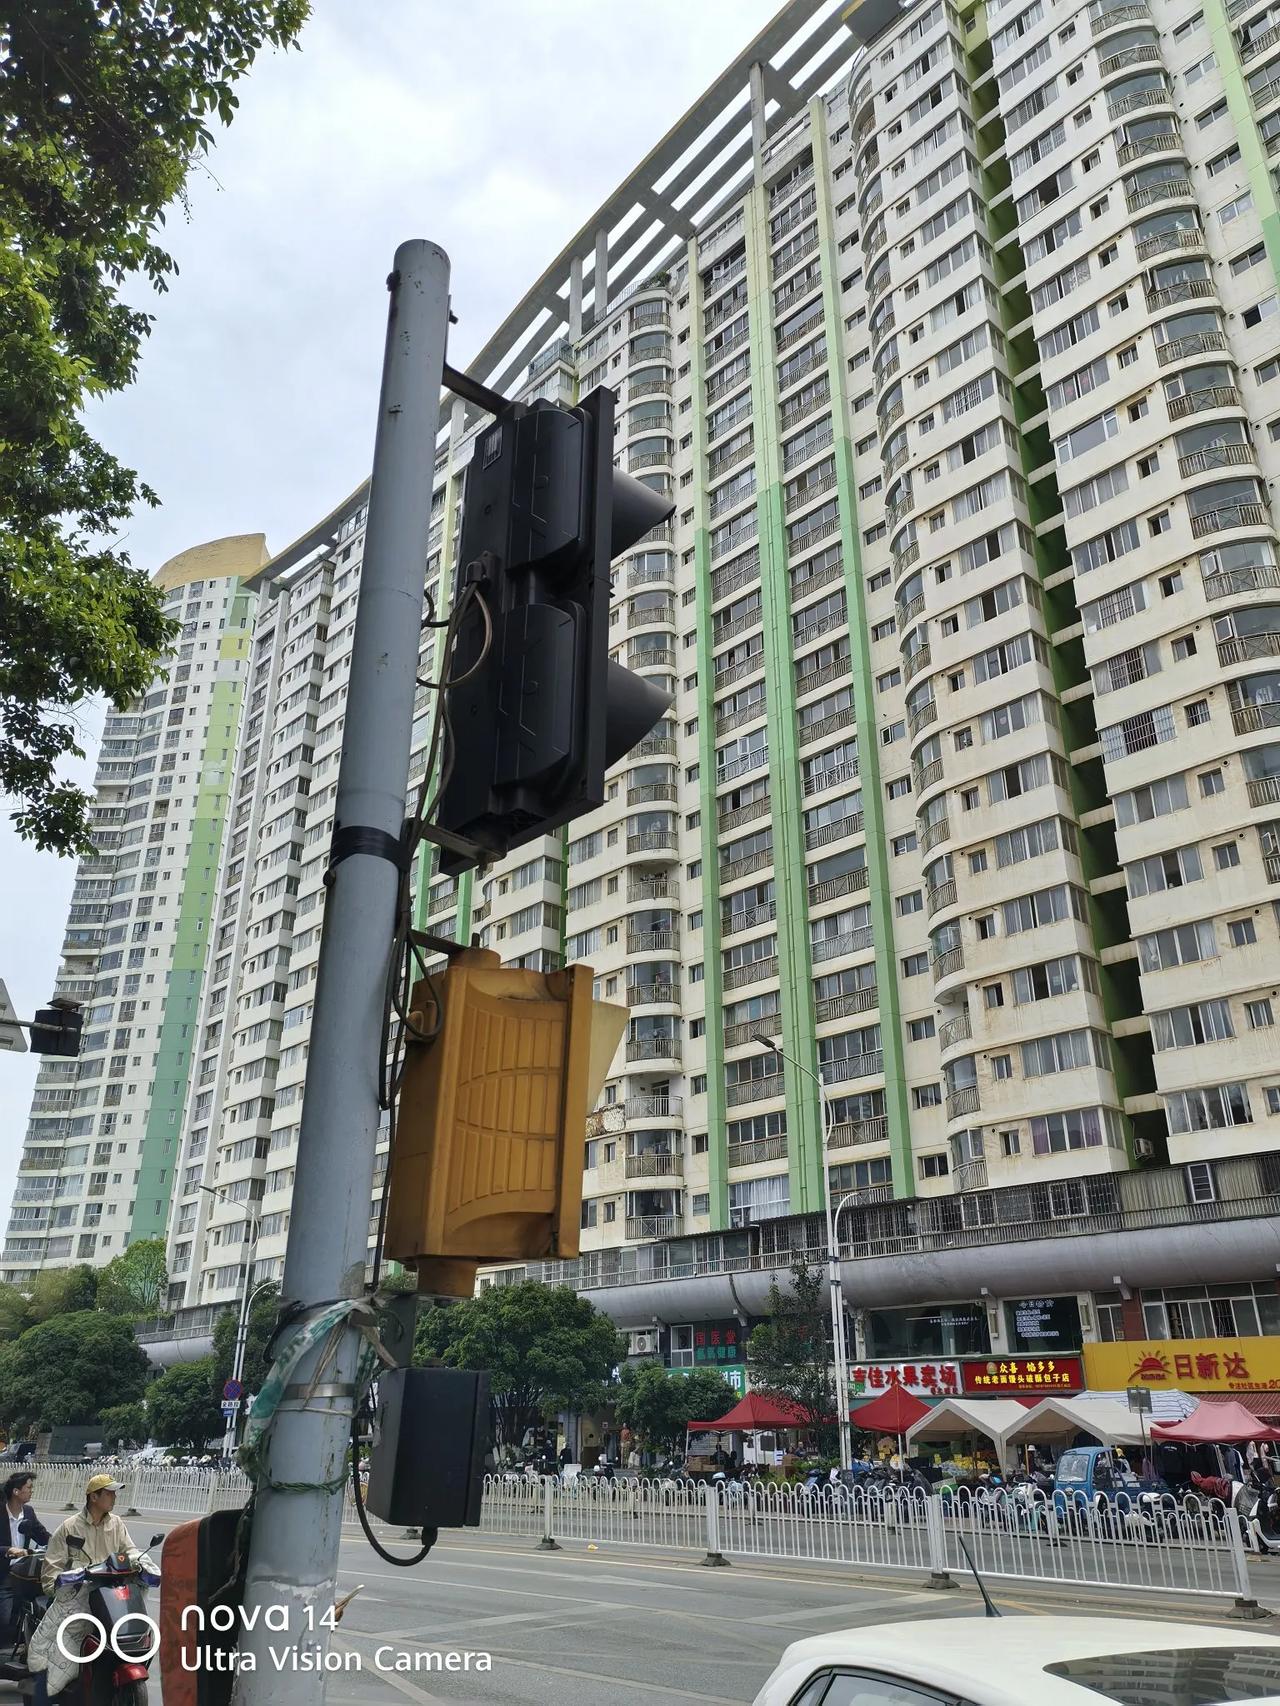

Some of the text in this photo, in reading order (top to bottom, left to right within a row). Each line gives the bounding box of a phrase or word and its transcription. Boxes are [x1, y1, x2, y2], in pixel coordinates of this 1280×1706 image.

[851, 1363, 957, 1389] 吉佳水果卖场
[999, 1361, 1018, 1374] 众喜
[1173, 1351, 1250, 1380] 日新达
